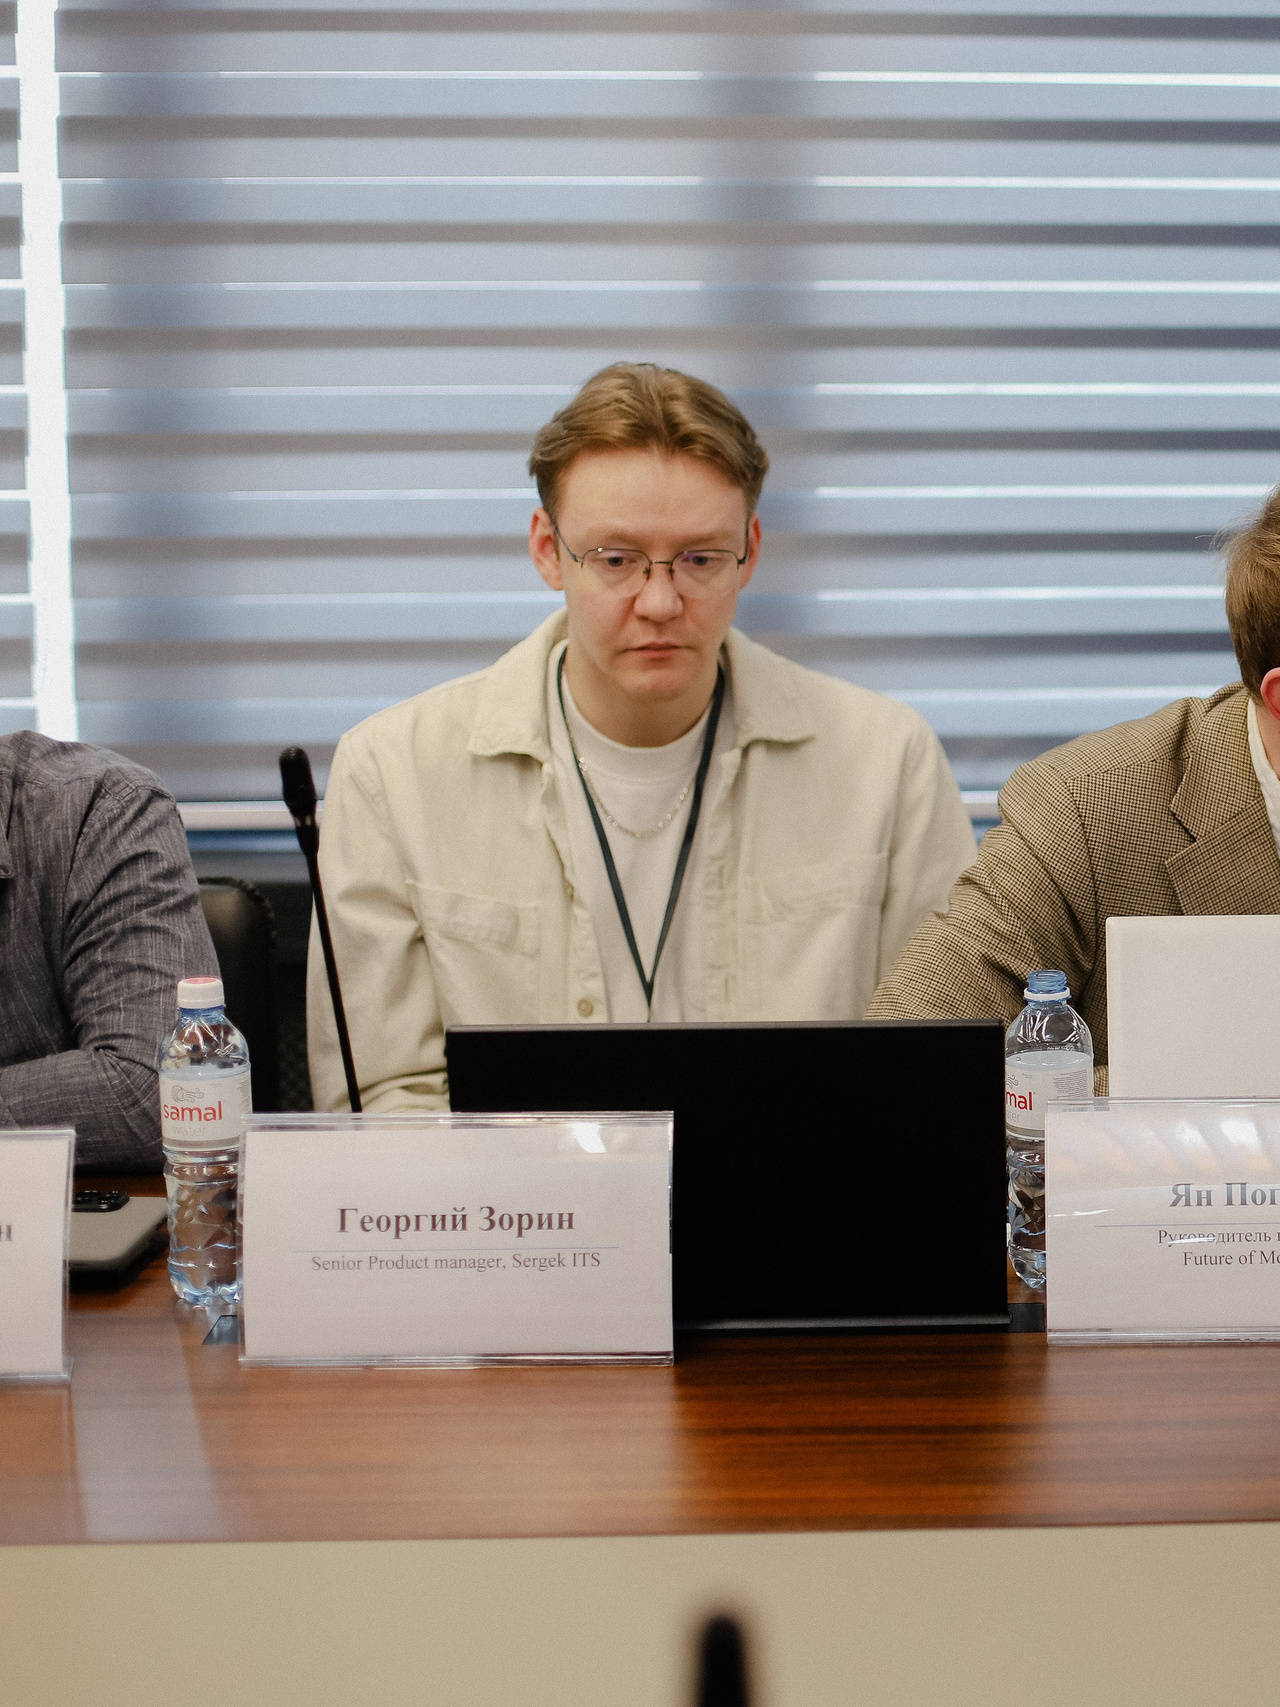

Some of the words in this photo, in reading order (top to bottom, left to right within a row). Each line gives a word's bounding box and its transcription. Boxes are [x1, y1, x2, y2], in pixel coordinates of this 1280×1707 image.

[163, 1100, 223, 1121] samal
[1006, 1091, 1033, 1110] mal
[1169, 1183, 1213, 1207] Ян
[336, 1206, 469, 1240] Георгий
[478, 1205, 576, 1238] Зорин
[311, 1256, 363, 1271] Senior
[368, 1255, 429, 1270] Product
[433, 1256, 507, 1273] manager,
[511, 1252, 567, 1272] Sergek
[571, 1252, 601, 1268] ITS
[1183, 1251, 1233, 1266] Future
[1238, 1250, 1256, 1265] of
